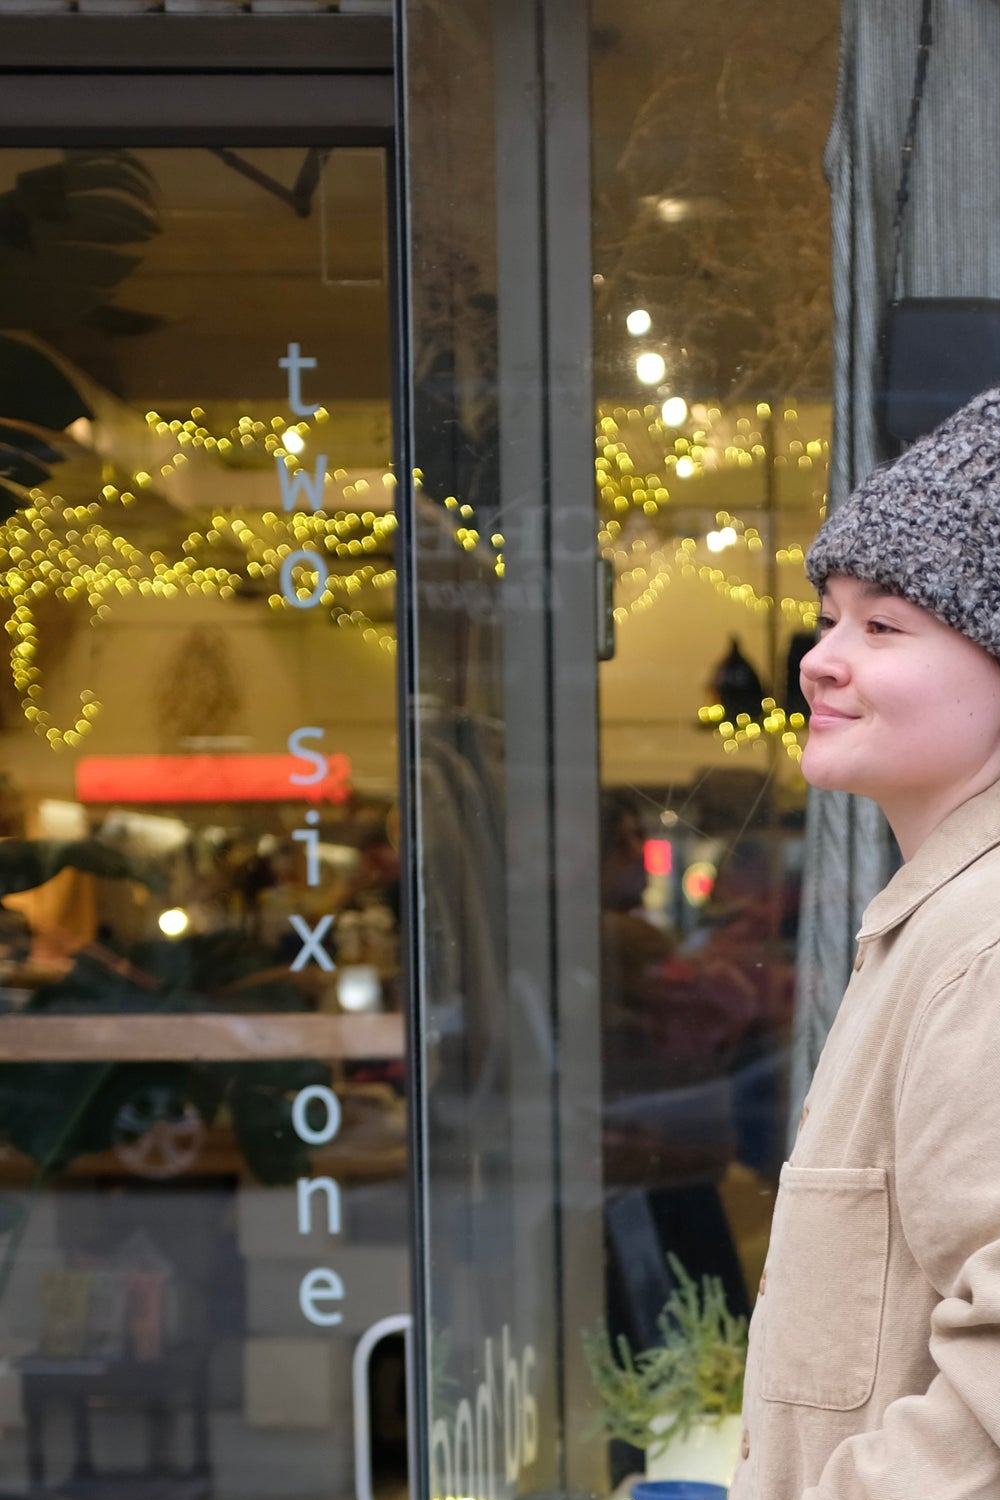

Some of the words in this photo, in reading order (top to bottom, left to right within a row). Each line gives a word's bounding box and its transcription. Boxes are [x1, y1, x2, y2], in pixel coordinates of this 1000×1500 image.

[278, 341, 327, 609] two
[287, 726, 336, 972] six
[291, 1084, 345, 1327] one
